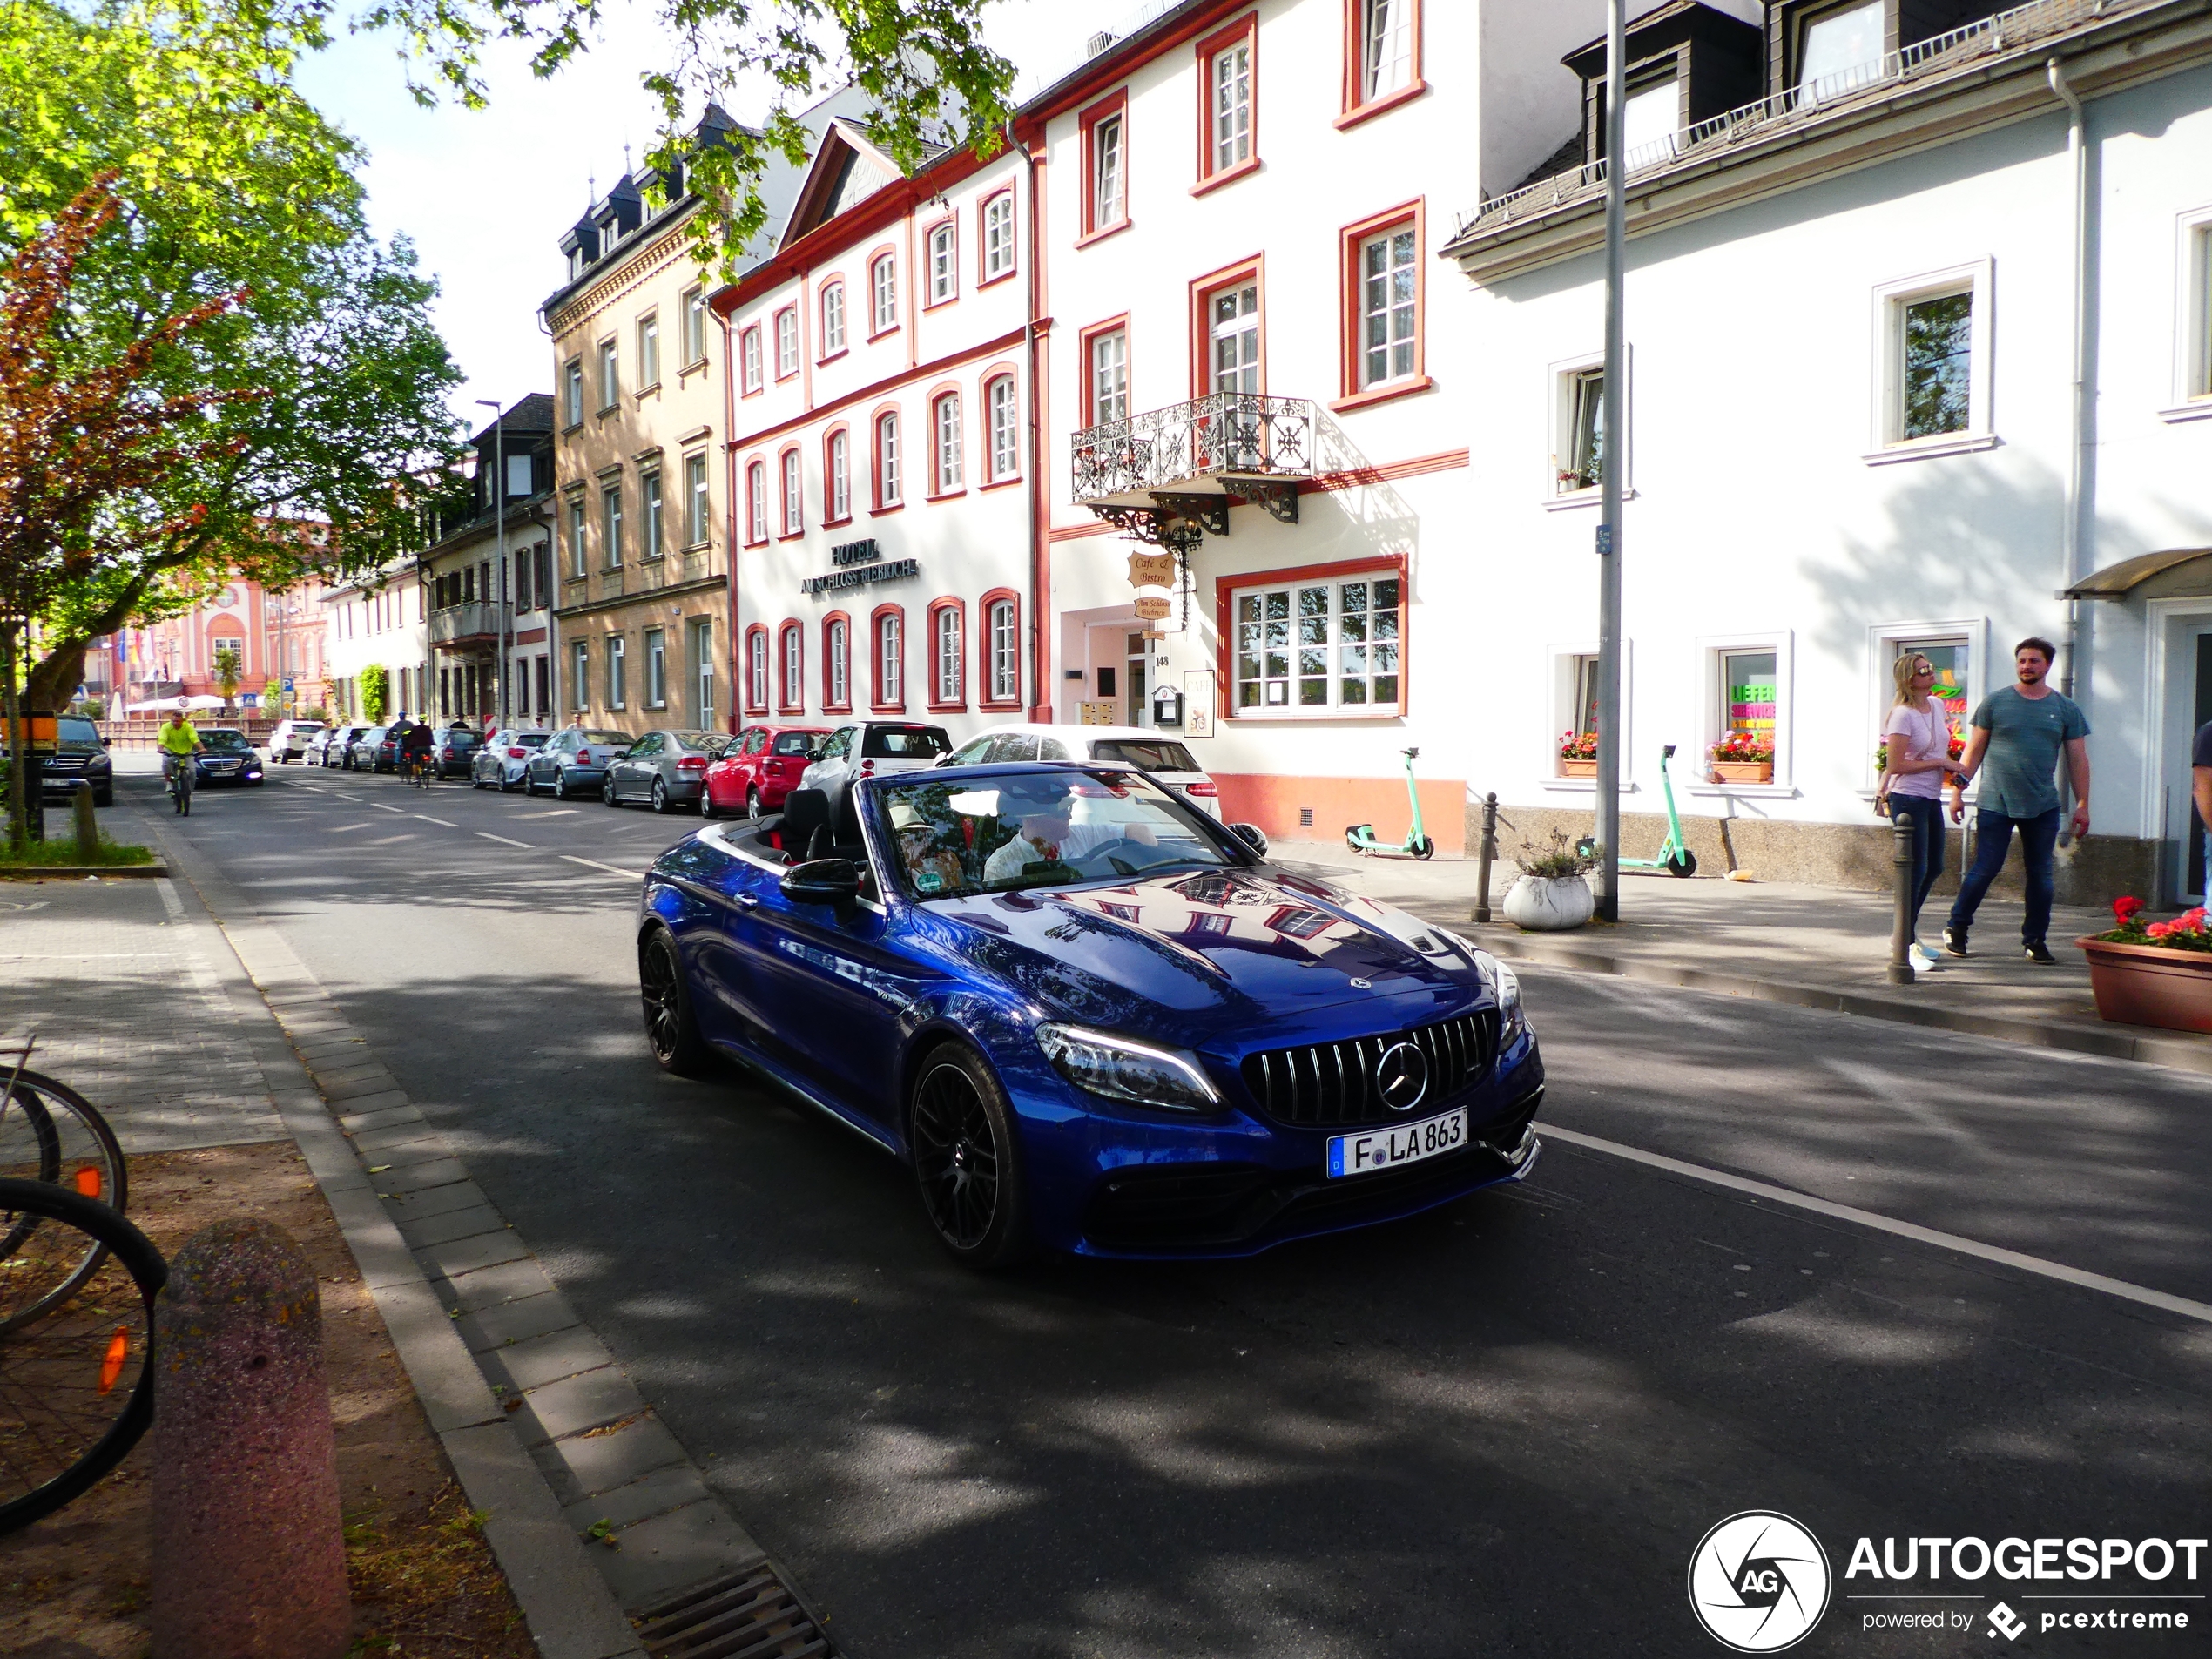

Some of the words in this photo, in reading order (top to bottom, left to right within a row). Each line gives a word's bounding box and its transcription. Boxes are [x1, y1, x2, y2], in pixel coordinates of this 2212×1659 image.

[830, 538, 875, 566] HOTEL
[1136, 557, 1155, 570] Café
[1159, 558, 1169, 570] &
[800, 577, 813, 594] AM
[816, 568, 858, 592] SCHLOSS
[860, 558, 913, 583] BIEBRICH
[1140, 572, 1165, 583] Bistro
[1150, 599, 1170, 608] Schloss
[1156, 656, 1169, 667] 148
[283, 679, 291, 691] P
[1186, 678, 1212, 692] CAFÉ
[1731, 685, 1776, 702] LIEFER
[1739, 719, 1755, 728] TAKE
[877, 989, 888, 1000] V8
[1355, 1137, 1372, 1169] F
[1390, 1129, 1420, 1163] LA
[1425, 1115, 1460, 1153] 863
[1333, 1160, 1339, 1170] D
